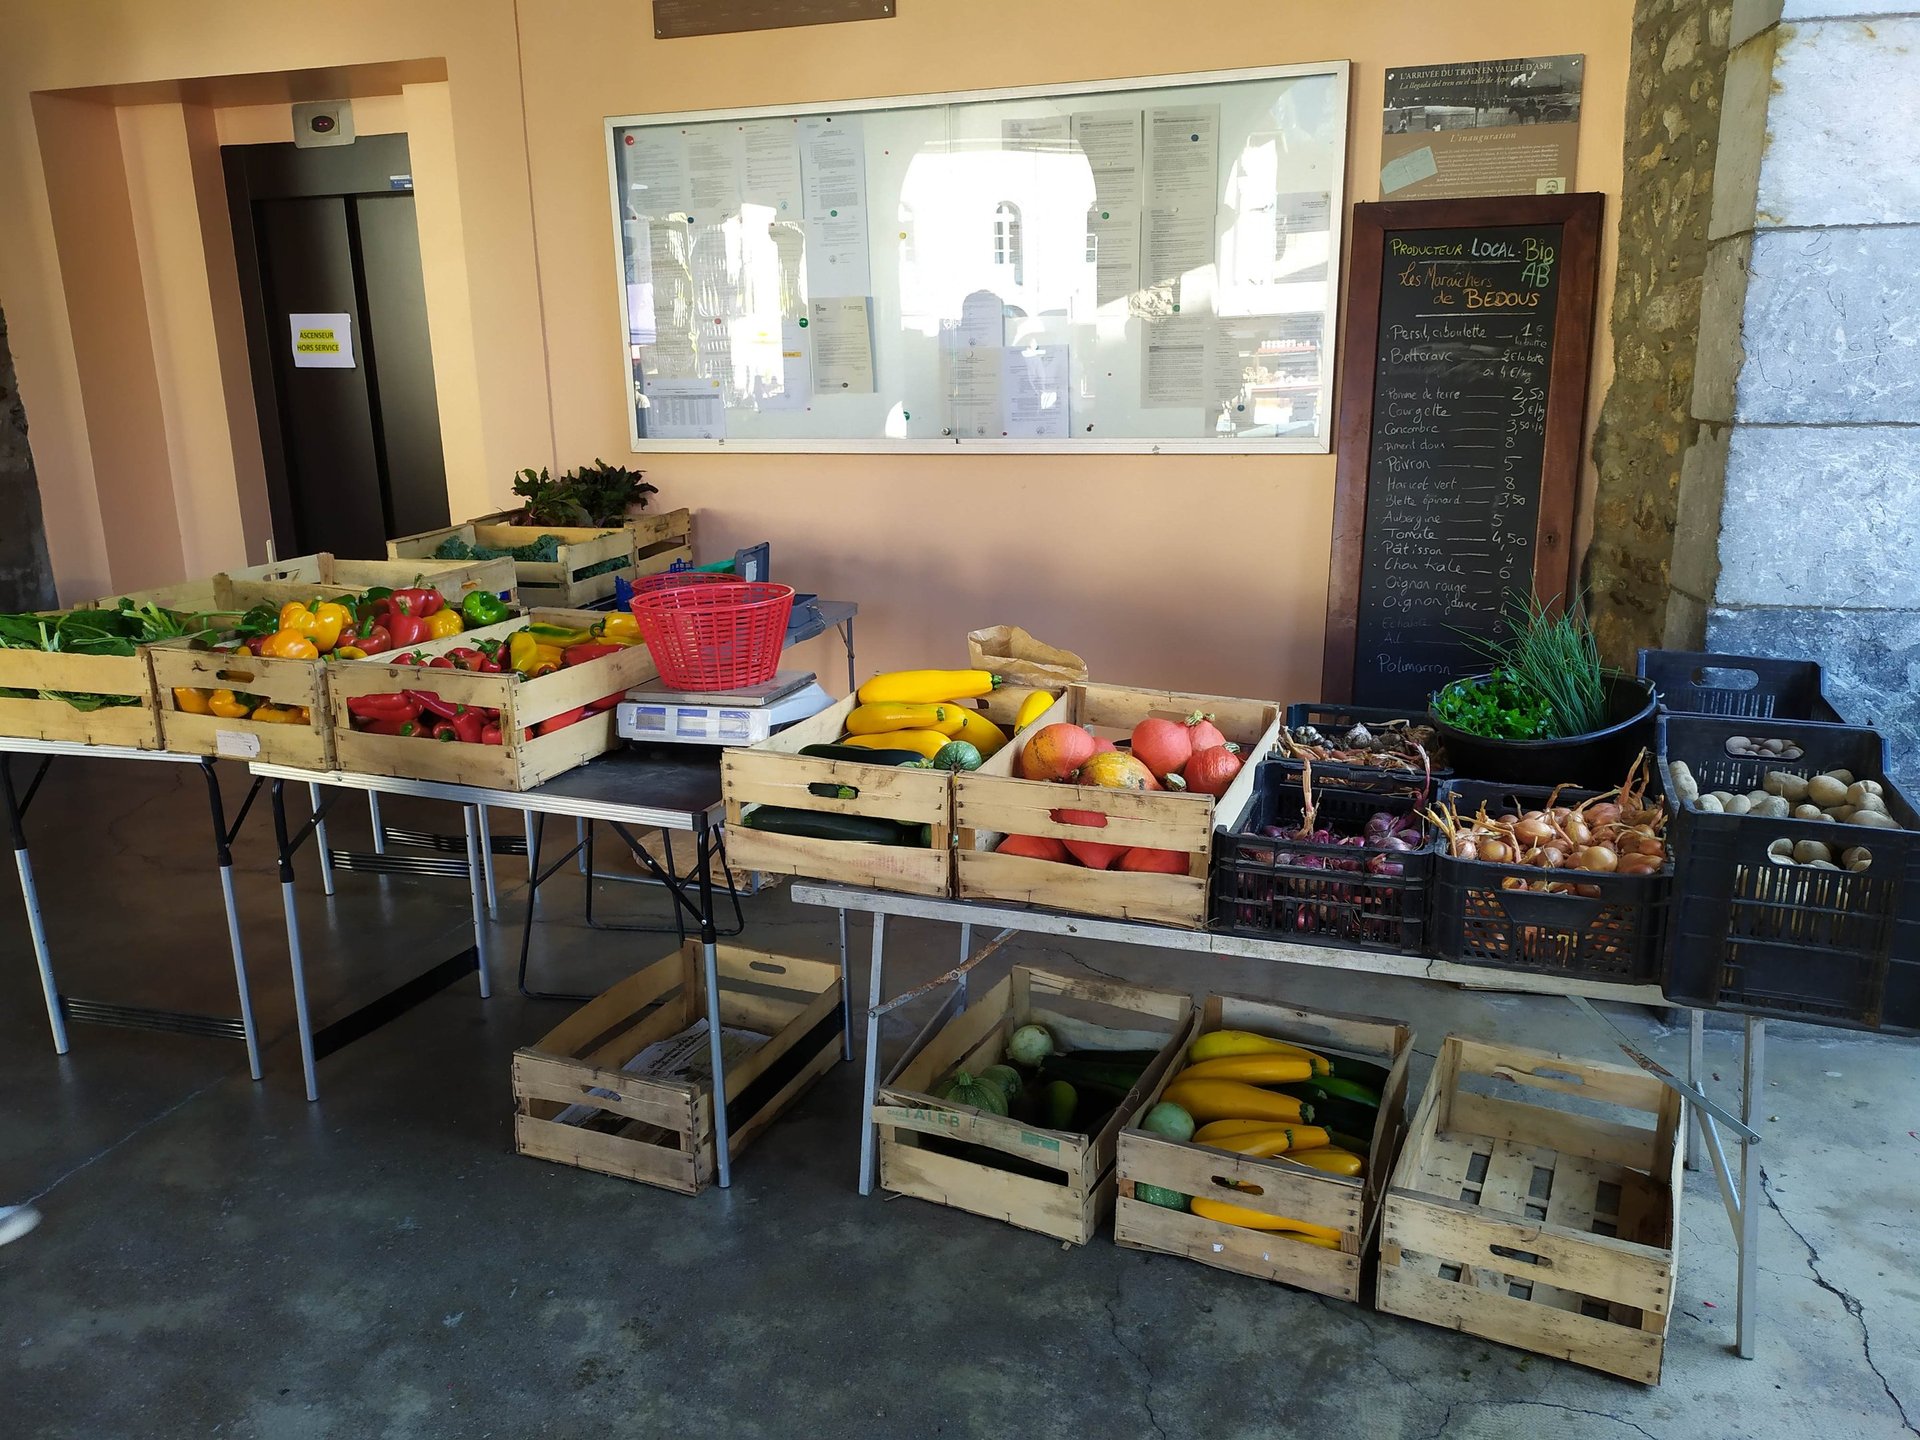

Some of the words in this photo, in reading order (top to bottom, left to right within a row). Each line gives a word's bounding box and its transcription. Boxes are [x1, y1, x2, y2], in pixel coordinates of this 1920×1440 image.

[1440, 69, 1453, 77] DU
[1455, 67, 1481, 76] TRAIN
[1482, 65, 1494, 74] EN
[1495, 63, 1525, 73] VALLÉE
[1525, 61, 1553, 71] D'ASPE
[1400, 82, 1409, 90] La
[1409, 80, 1432, 91] llegada
[1431, 78, 1442, 88] del
[1442, 78, 1455, 86] tren
[1470, 75, 1486, 84] valle
[1485, 75, 1495, 84] de
[1450, 131, 1518, 143] L'inauguration
[1398, 261, 1421, 287] Les
[1521, 262, 1553, 288] AB
[1433, 290, 1455, 304] de
[1463, 288, 1540, 309] BEDOUS
[300, 331, 334, 339] ASCENSEUR
[1422, 387, 1432, 399] de
[1436, 388, 1461, 399] terre
[1505, 436, 1515, 448] 8
[1385, 456, 1431, 473] Poivron
[1386, 476, 1430, 492] Haricot
[1434, 480, 1457, 489] vert
[1504, 477, 1516, 490] 8
[1382, 512, 1442, 531] Aubergine
[1491, 513, 1505, 528] 5
[1382, 528, 1439, 540] Tomate
[1384, 557, 1418, 571] Chou
[1385, 576, 1430, 597] Oignon
[1434, 582, 1468, 600] rouge
[1382, 595, 1442, 613] Oignon
